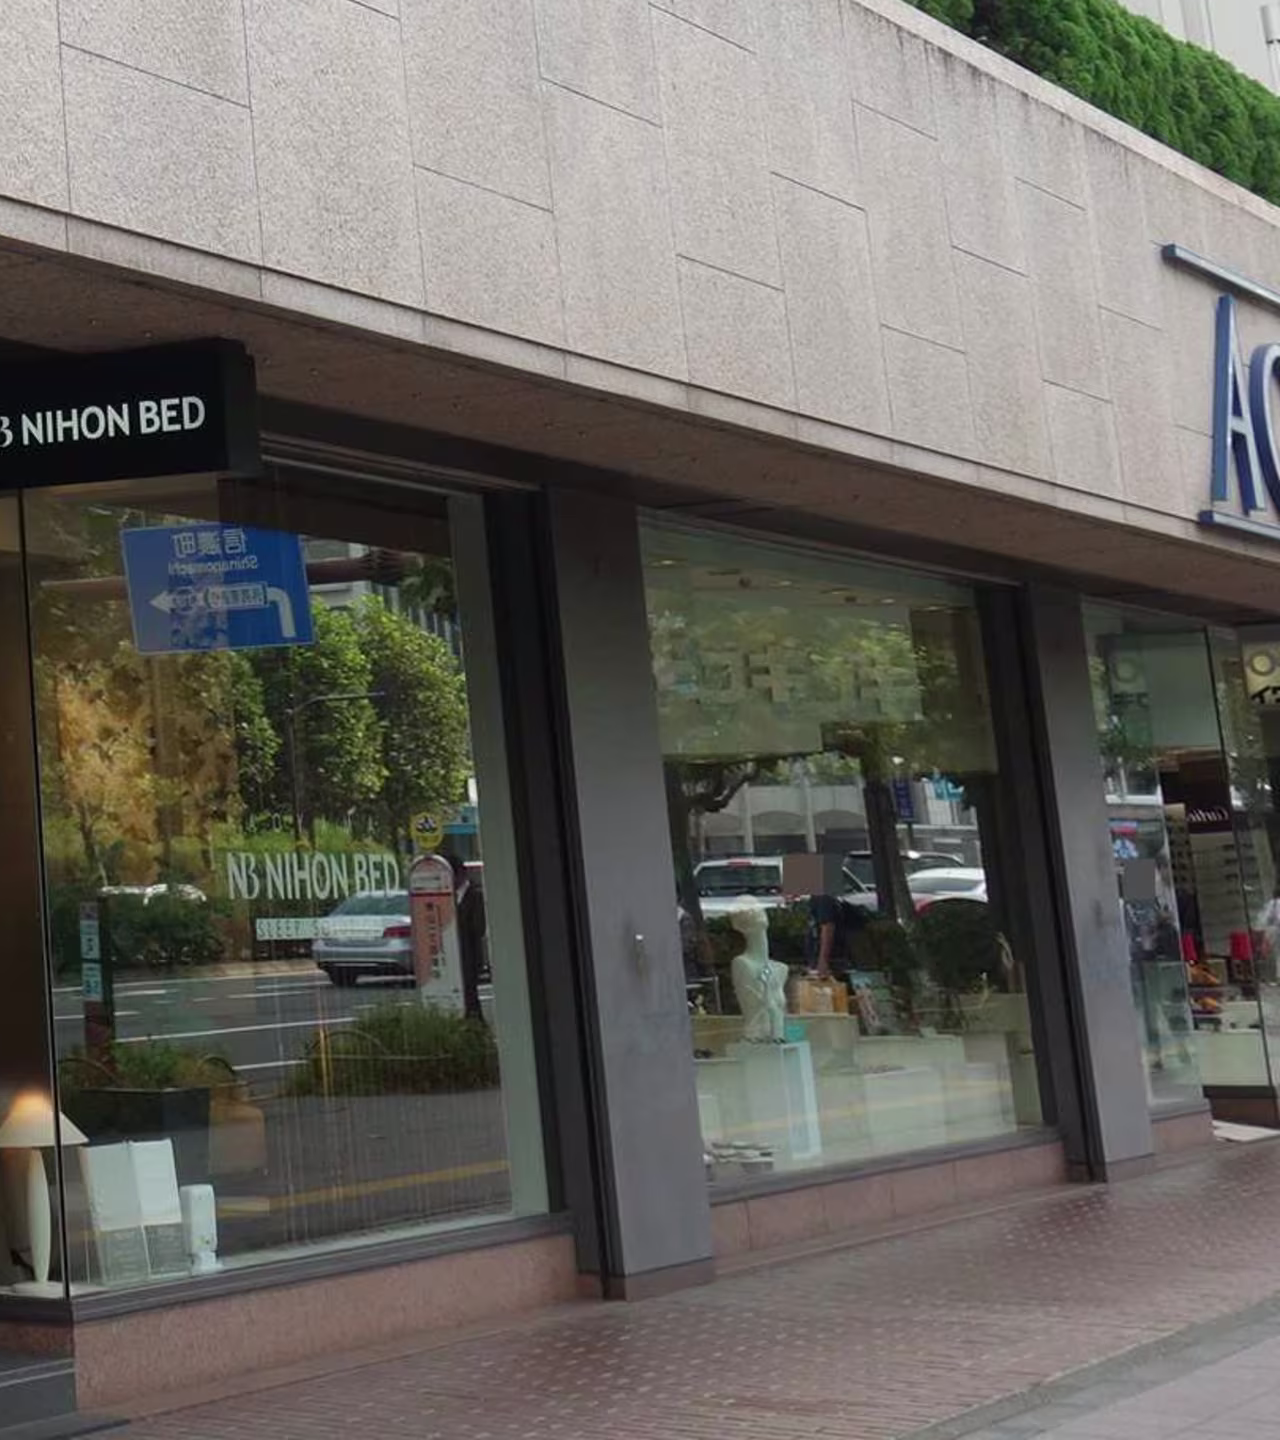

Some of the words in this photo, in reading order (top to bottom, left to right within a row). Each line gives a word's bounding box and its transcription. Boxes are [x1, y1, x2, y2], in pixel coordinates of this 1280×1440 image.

[21, 402, 130, 446] NIHON
[138, 395, 205, 435] BED
[266, 852, 350, 900] NIHON
[353, 853, 401, 897] BED
